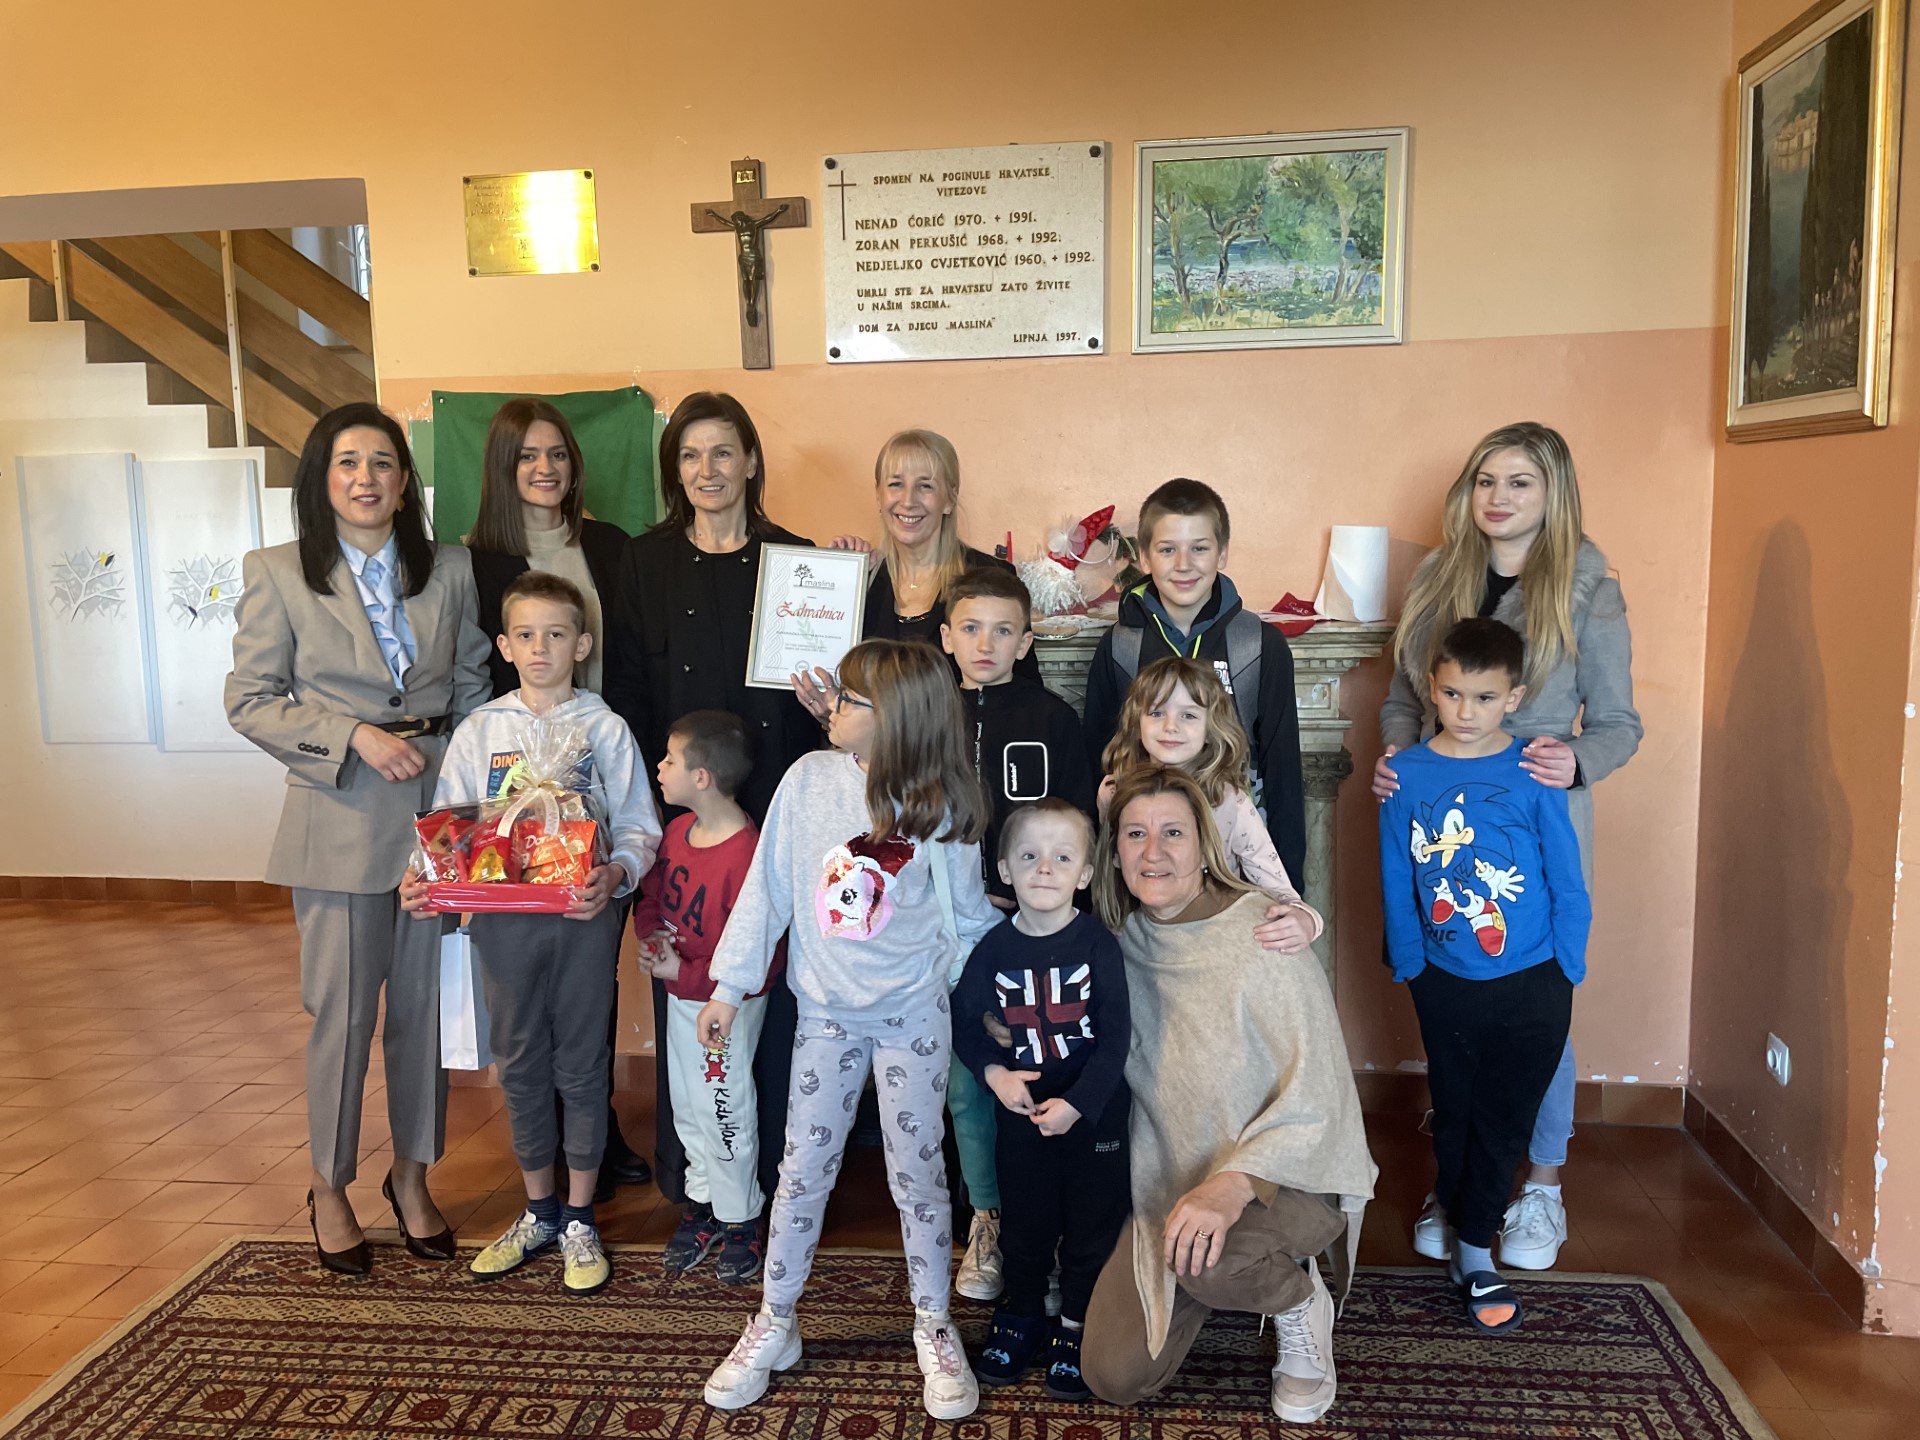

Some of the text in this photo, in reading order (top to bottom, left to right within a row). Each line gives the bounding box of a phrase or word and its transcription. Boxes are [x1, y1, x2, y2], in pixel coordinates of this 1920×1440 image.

[874, 167, 1050, 185] SPOMEN NA POGINULE HRVATSKE
[936, 186, 987, 197] VITEZOVE
[855, 218, 898, 230] NENAD
[907, 213, 944, 227] ĆORIĆ
[954, 213, 986, 226] 1970.
[1008, 211, 1037, 224] 1991.
[855, 238, 899, 251] ZORAN
[909, 233, 967, 249] PERKUŠIĆ
[977, 234, 1008, 246] 1968.
[856, 259, 923, 272] NEDJELJKO
[930, 253, 1007, 269] CVJETKOVIĆ
[1014, 253, 1046, 266] 1960.
[1064, 251, 1095, 264] 1992.
[857, 280, 1071, 298] UMRLI STE ZA HRVATSKU ZATO ŽIVITE
[857, 300, 950, 311] U NAŠIM SRCIMA.
[859, 324, 879, 333] DOM
[887, 323, 901, 332] ZA
[908, 322, 938, 331] DJECU
[1013, 332, 1081, 343] LIPNJA 1997.
